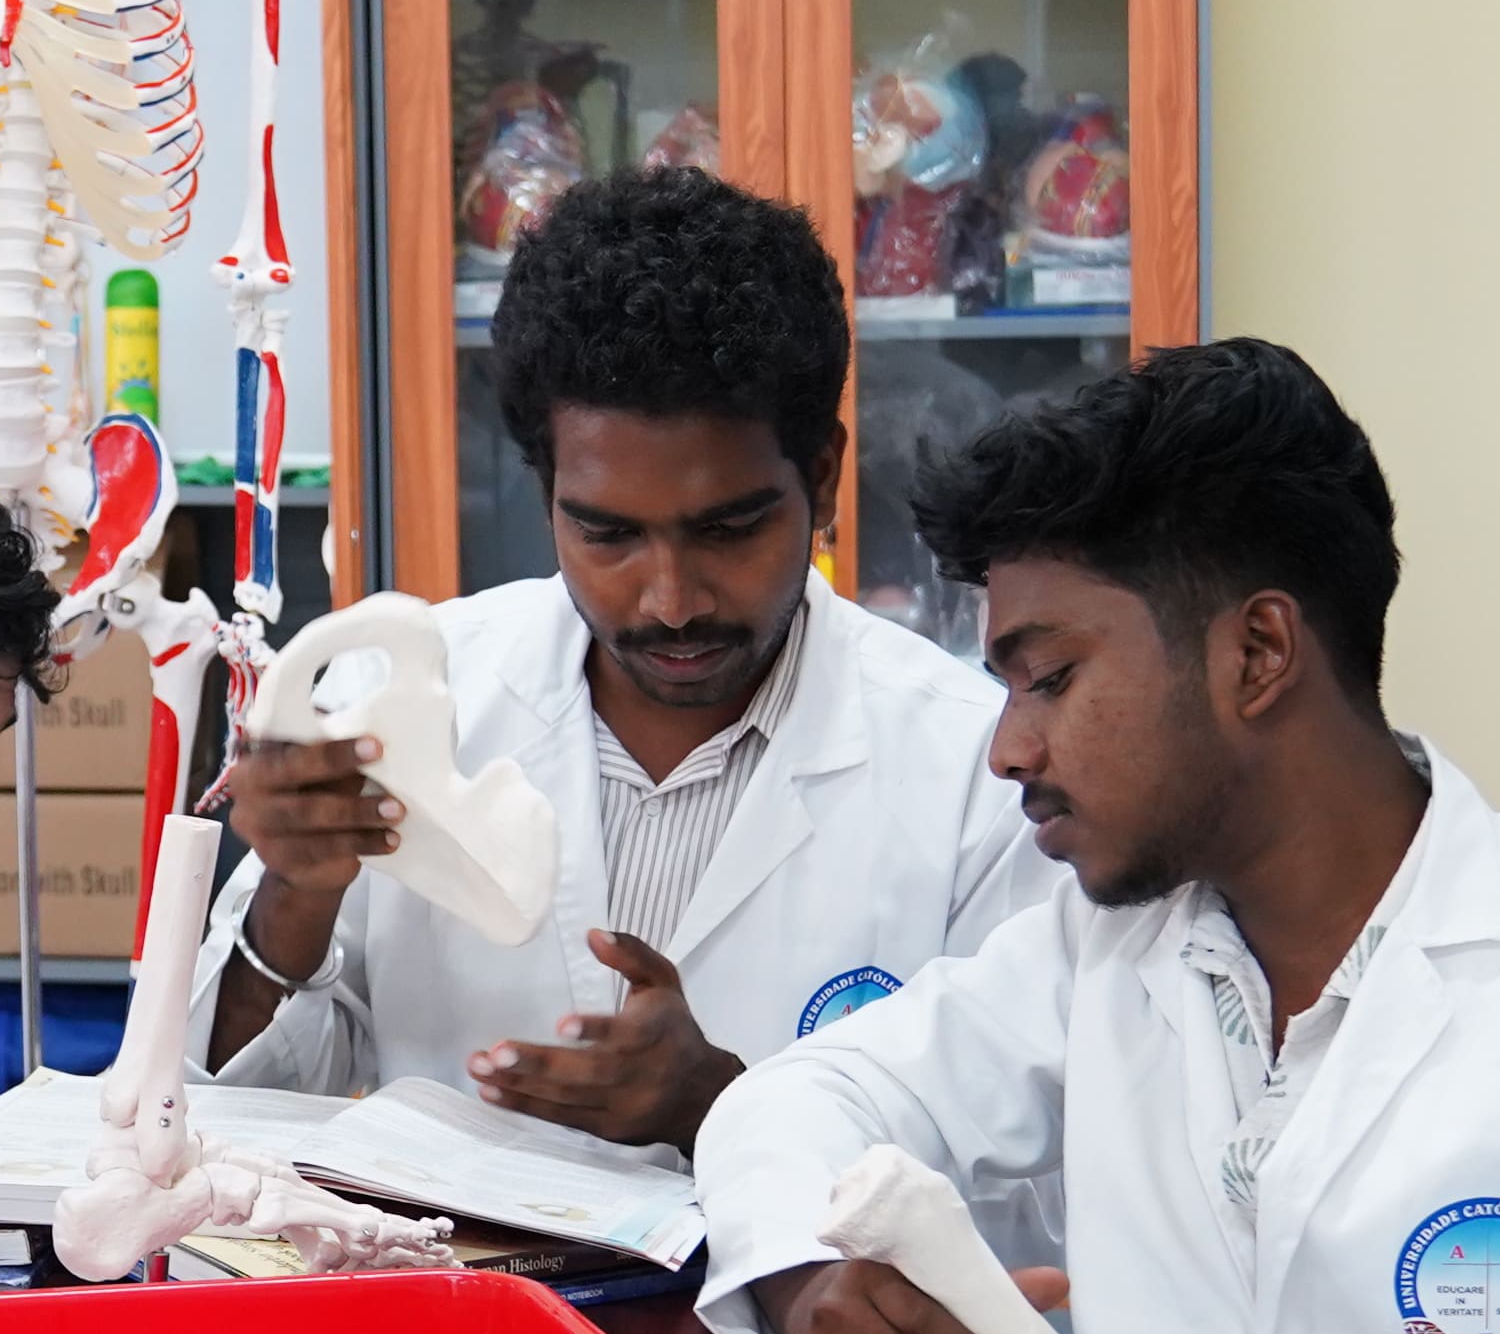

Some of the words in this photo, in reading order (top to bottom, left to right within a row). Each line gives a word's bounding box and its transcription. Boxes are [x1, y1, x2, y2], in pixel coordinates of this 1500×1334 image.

[69, 698, 126, 726] Skull
[80, 865, 135, 894] Skull
[802, 974, 856, 1035] IVERSIDADE
[857, 970, 900, 995] CATÓLIC
[1400, 1209, 1460, 1309] UNIVERSIDADE
[1450, 1245, 1465, 1260] A
[510, 1254, 566, 1274] Histology
[1437, 1285, 1485, 1295] EDUCARE
[1455, 1297, 1466, 1305] IN
[1437, 1308, 1485, 1317] VERITATE
